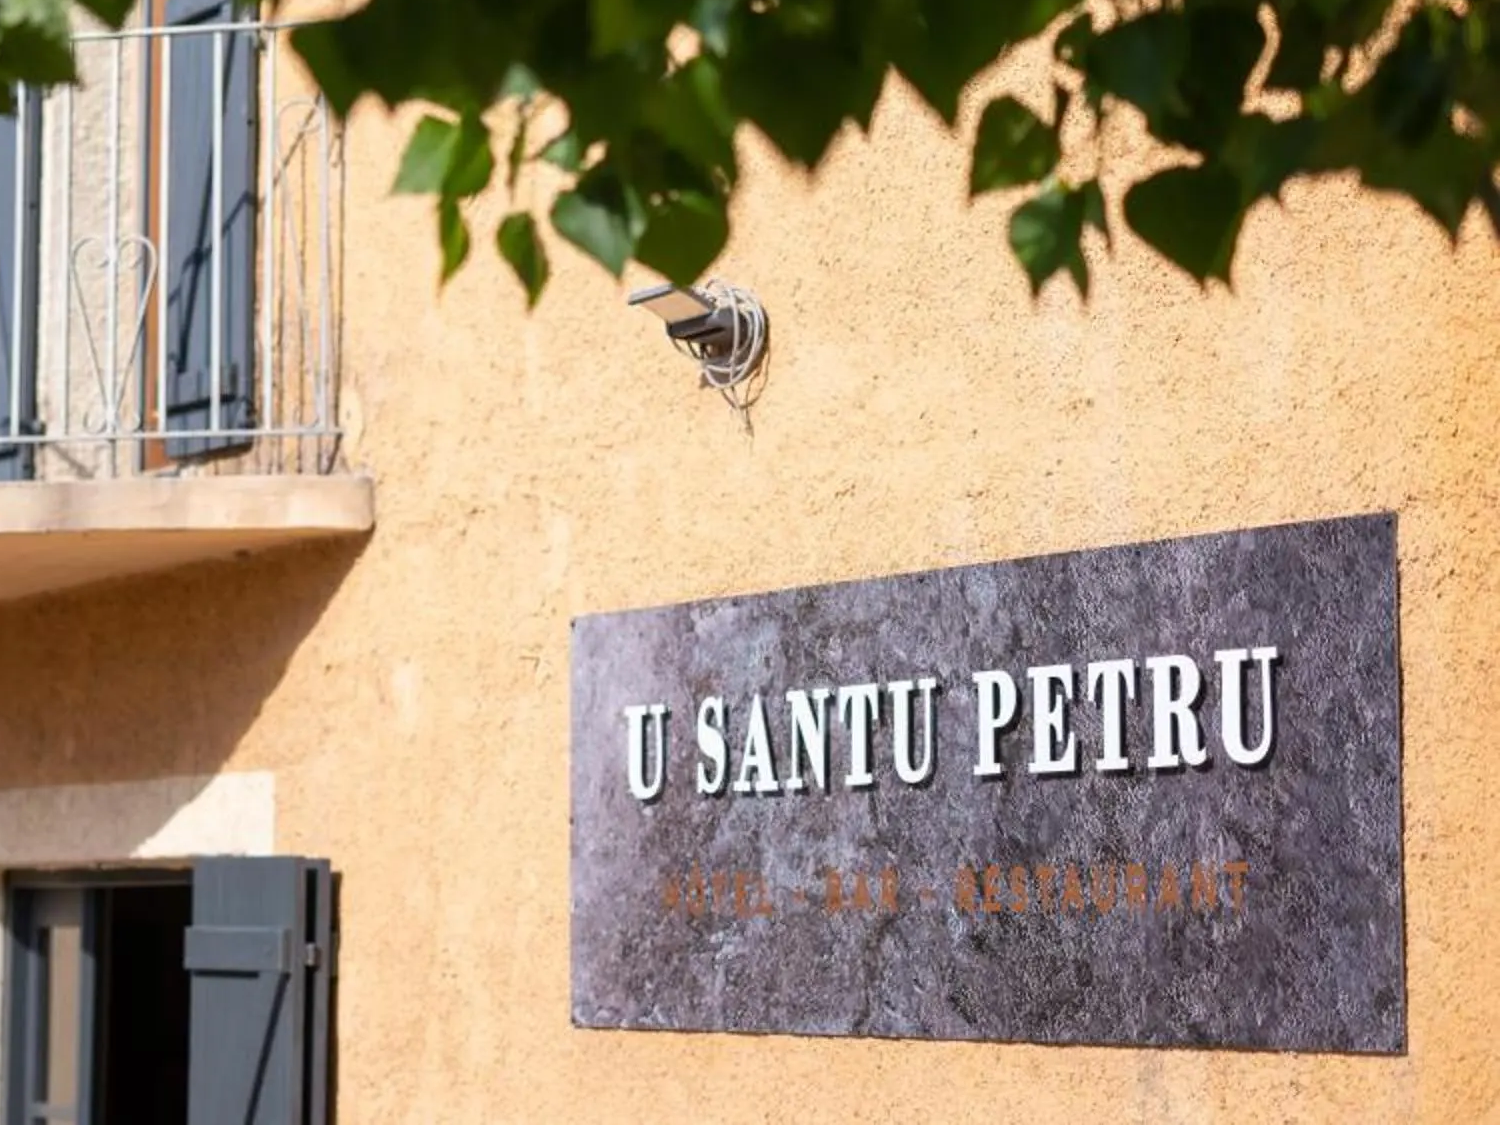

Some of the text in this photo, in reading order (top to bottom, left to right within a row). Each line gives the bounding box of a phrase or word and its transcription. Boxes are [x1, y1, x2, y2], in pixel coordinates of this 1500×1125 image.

[624, 646, 1277, 800] U SANTU PETRU
[955, 860, 1250, 917] RESTAURANT
